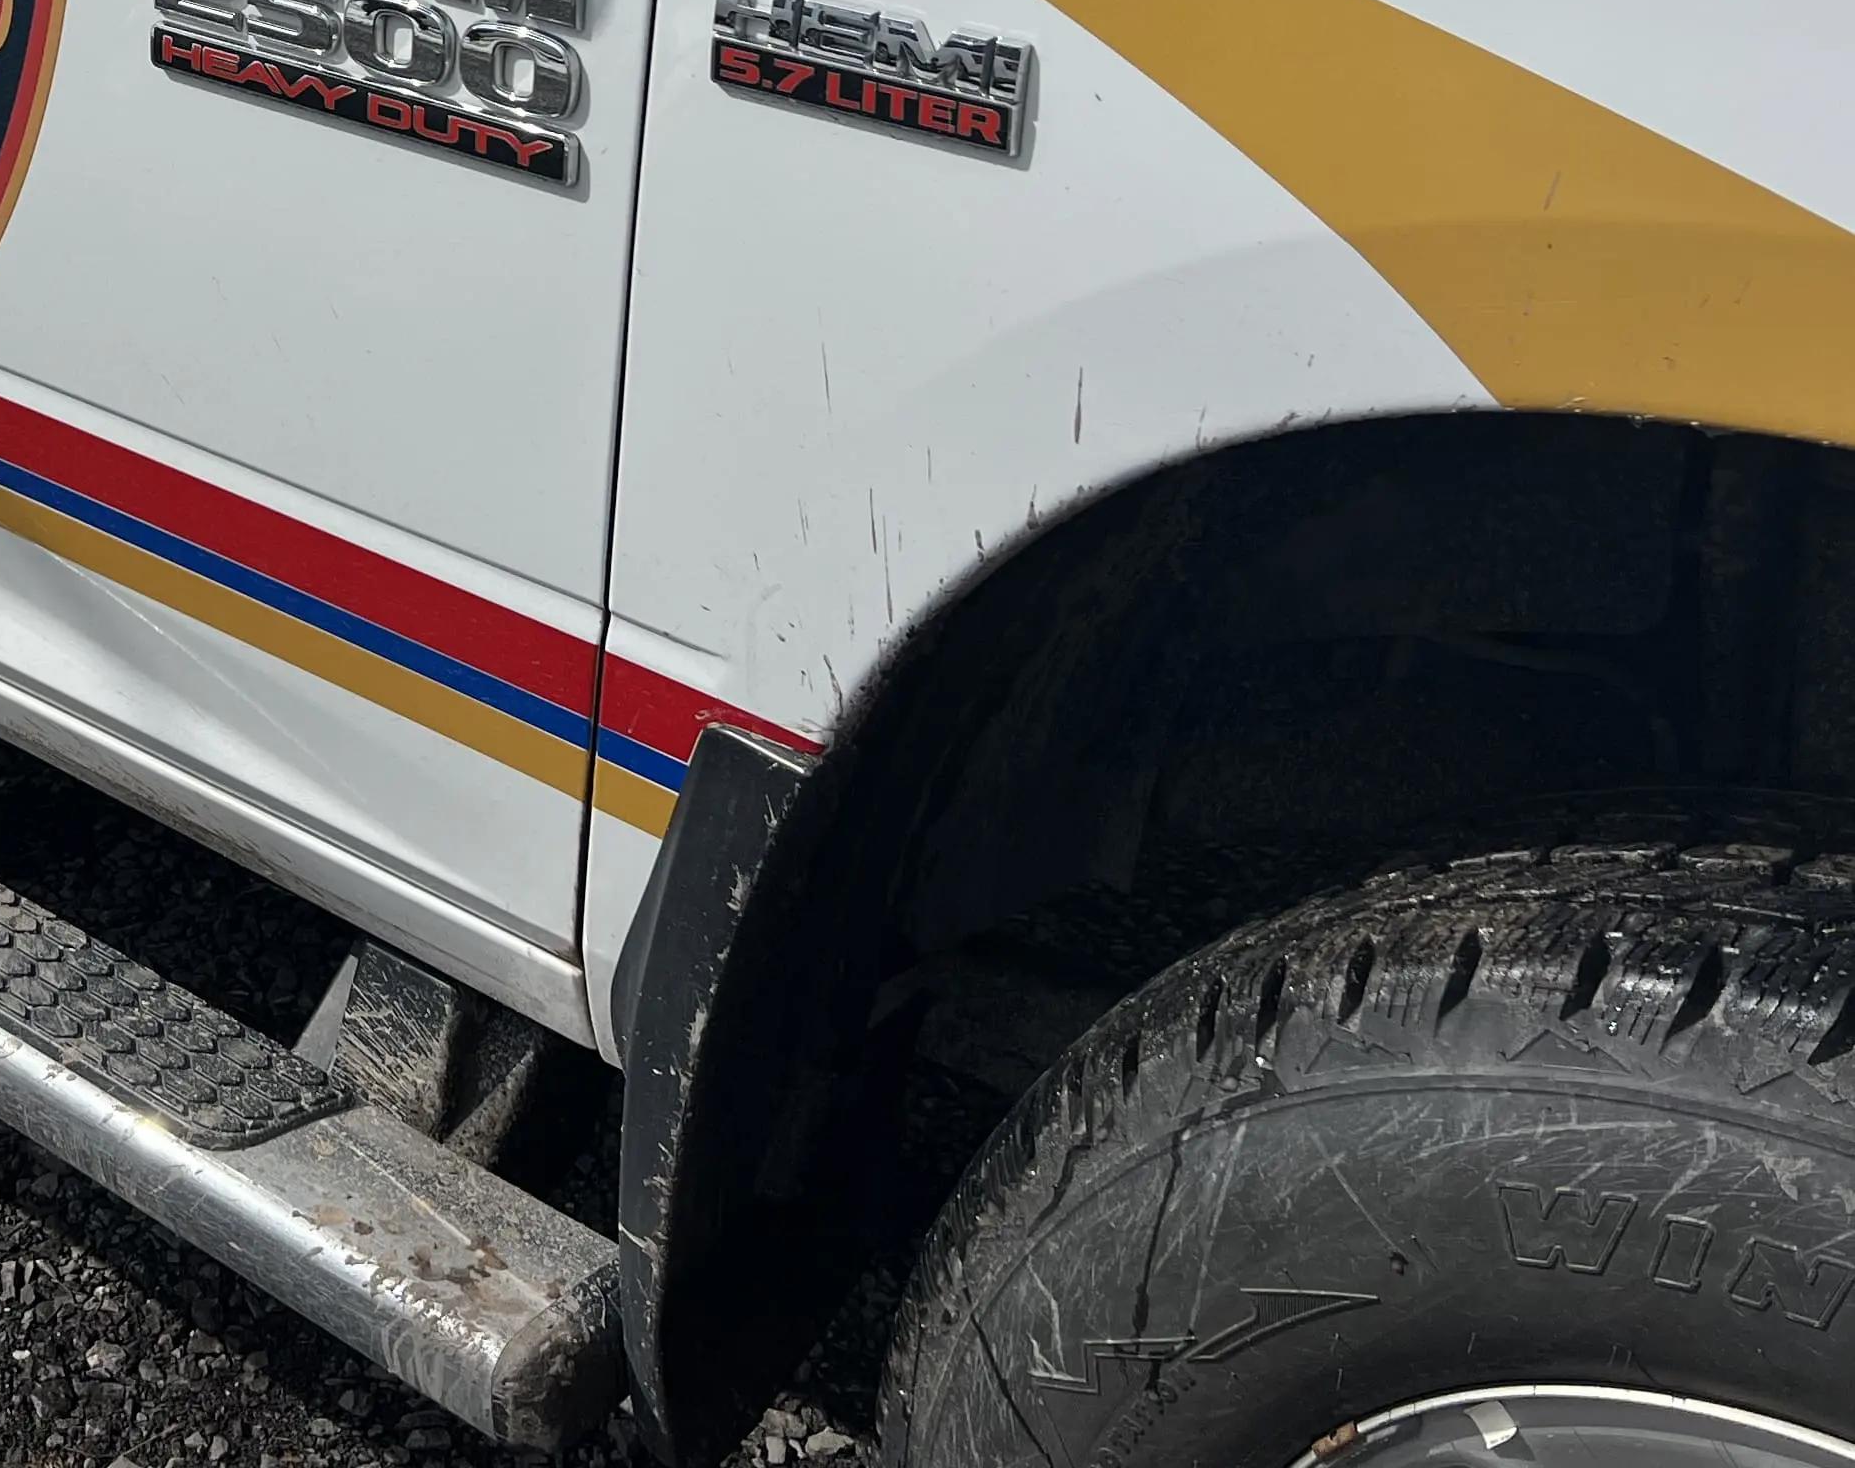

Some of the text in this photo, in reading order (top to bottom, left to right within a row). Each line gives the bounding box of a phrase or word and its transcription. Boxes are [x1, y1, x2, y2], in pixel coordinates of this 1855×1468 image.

[160, 35, 554, 168] HEAVY DUTY
[718, 45, 1002, 145] 5.7 LITER
